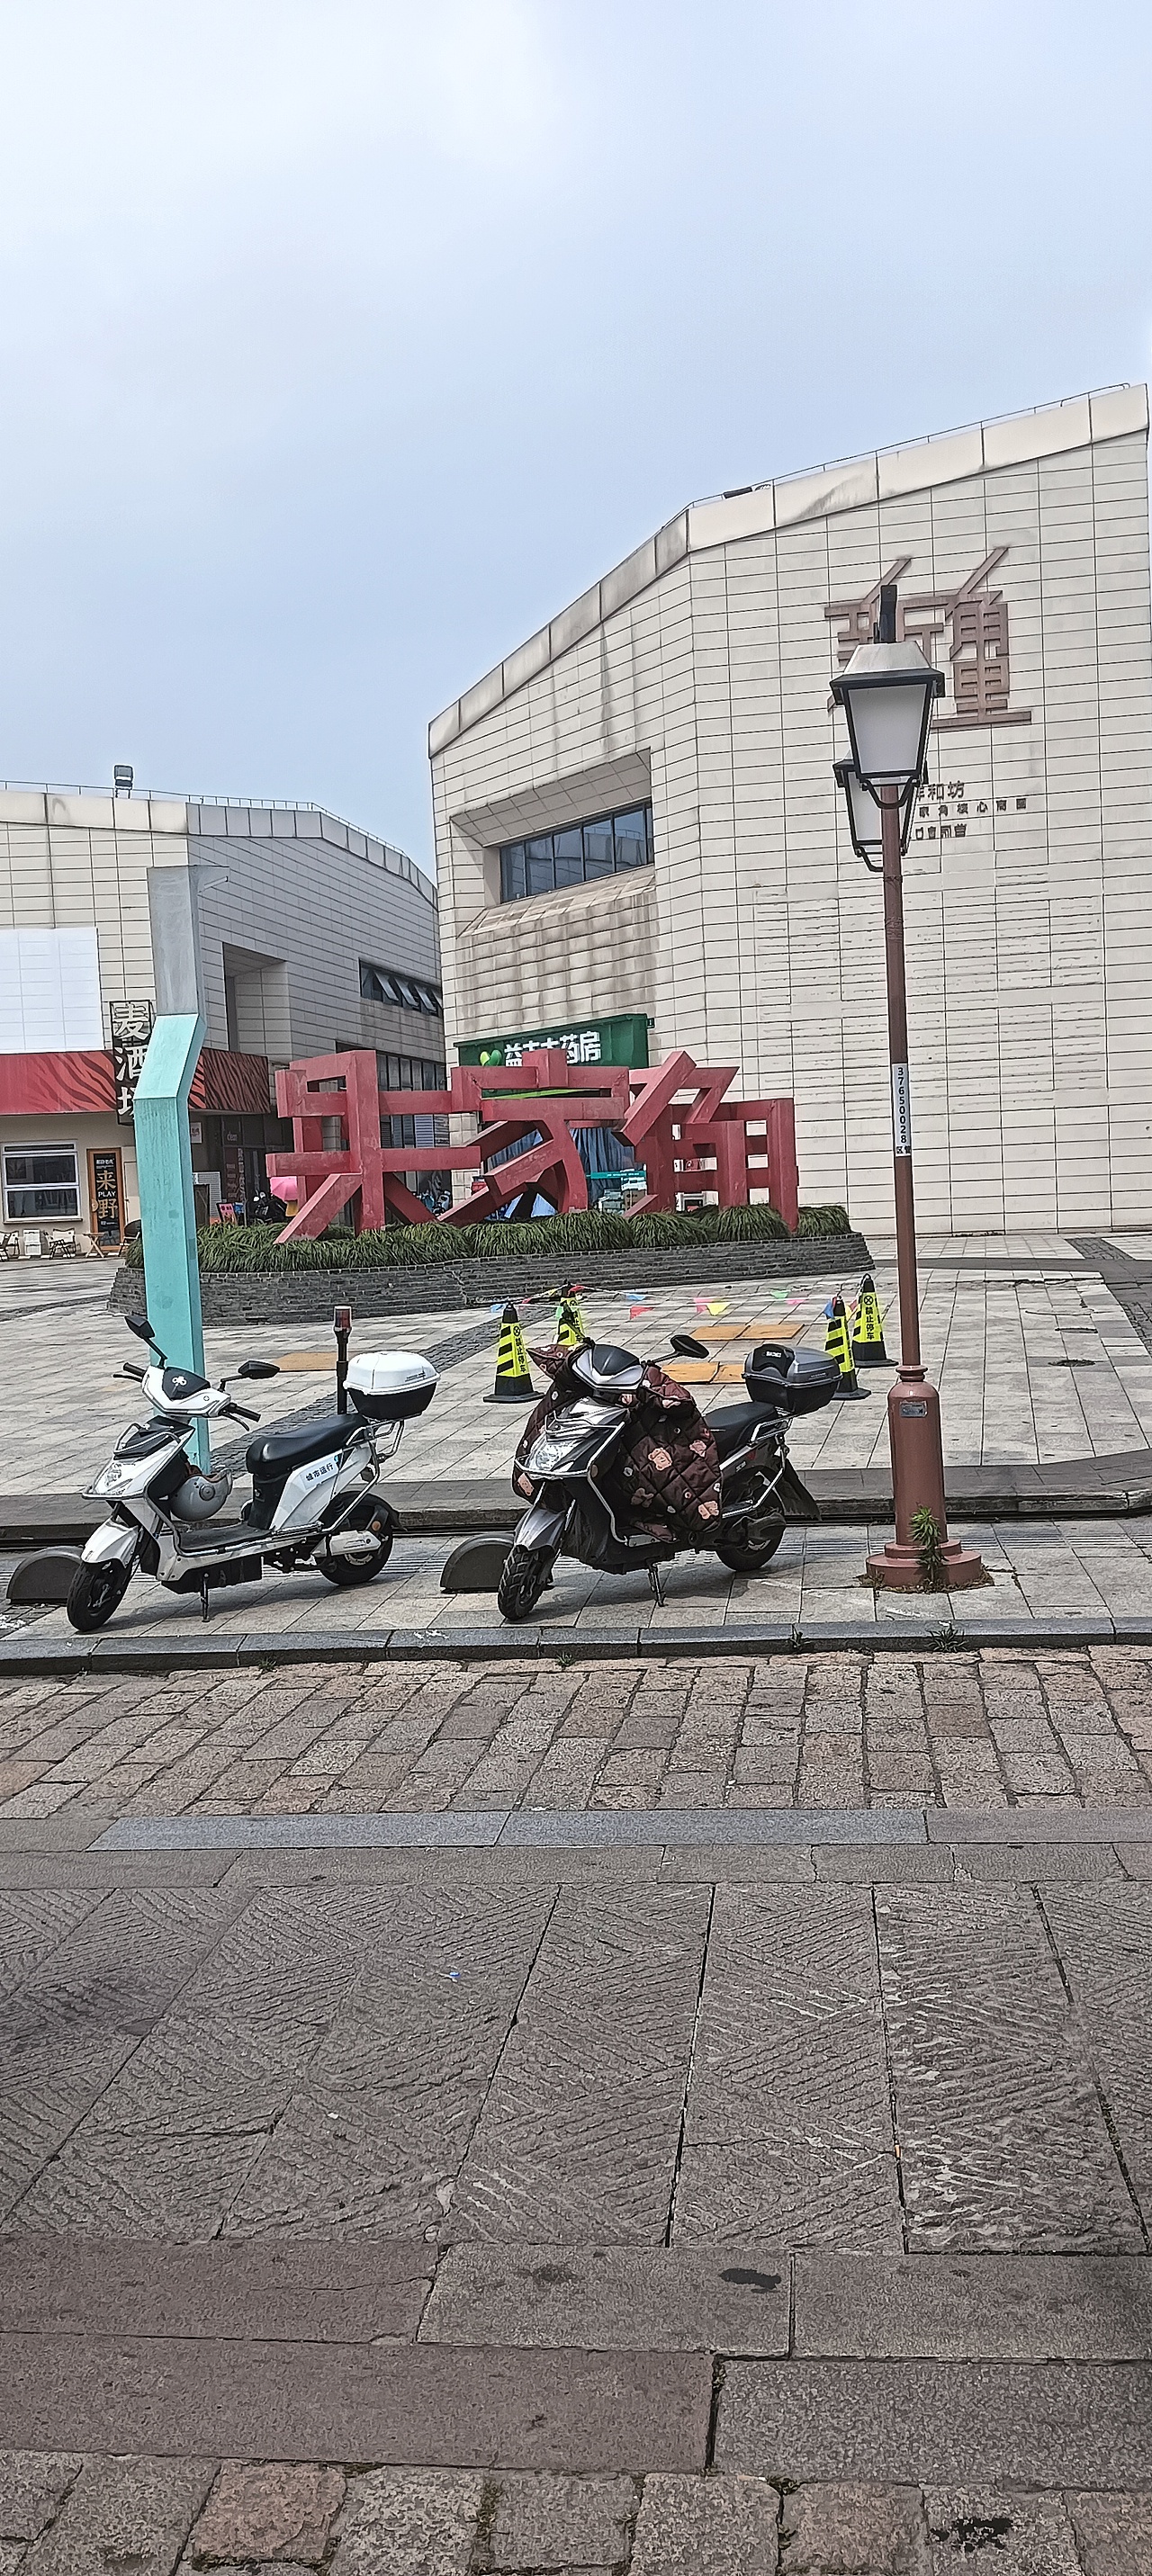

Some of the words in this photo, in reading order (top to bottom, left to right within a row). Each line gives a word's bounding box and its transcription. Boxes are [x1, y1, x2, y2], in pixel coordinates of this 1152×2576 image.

[897, 1067, 907, 1144] 37650028
[95, 1170, 117, 1190] 来
[98, 1198, 118, 1219] 野
[865, 1306, 875, 1341] 禁止停车
